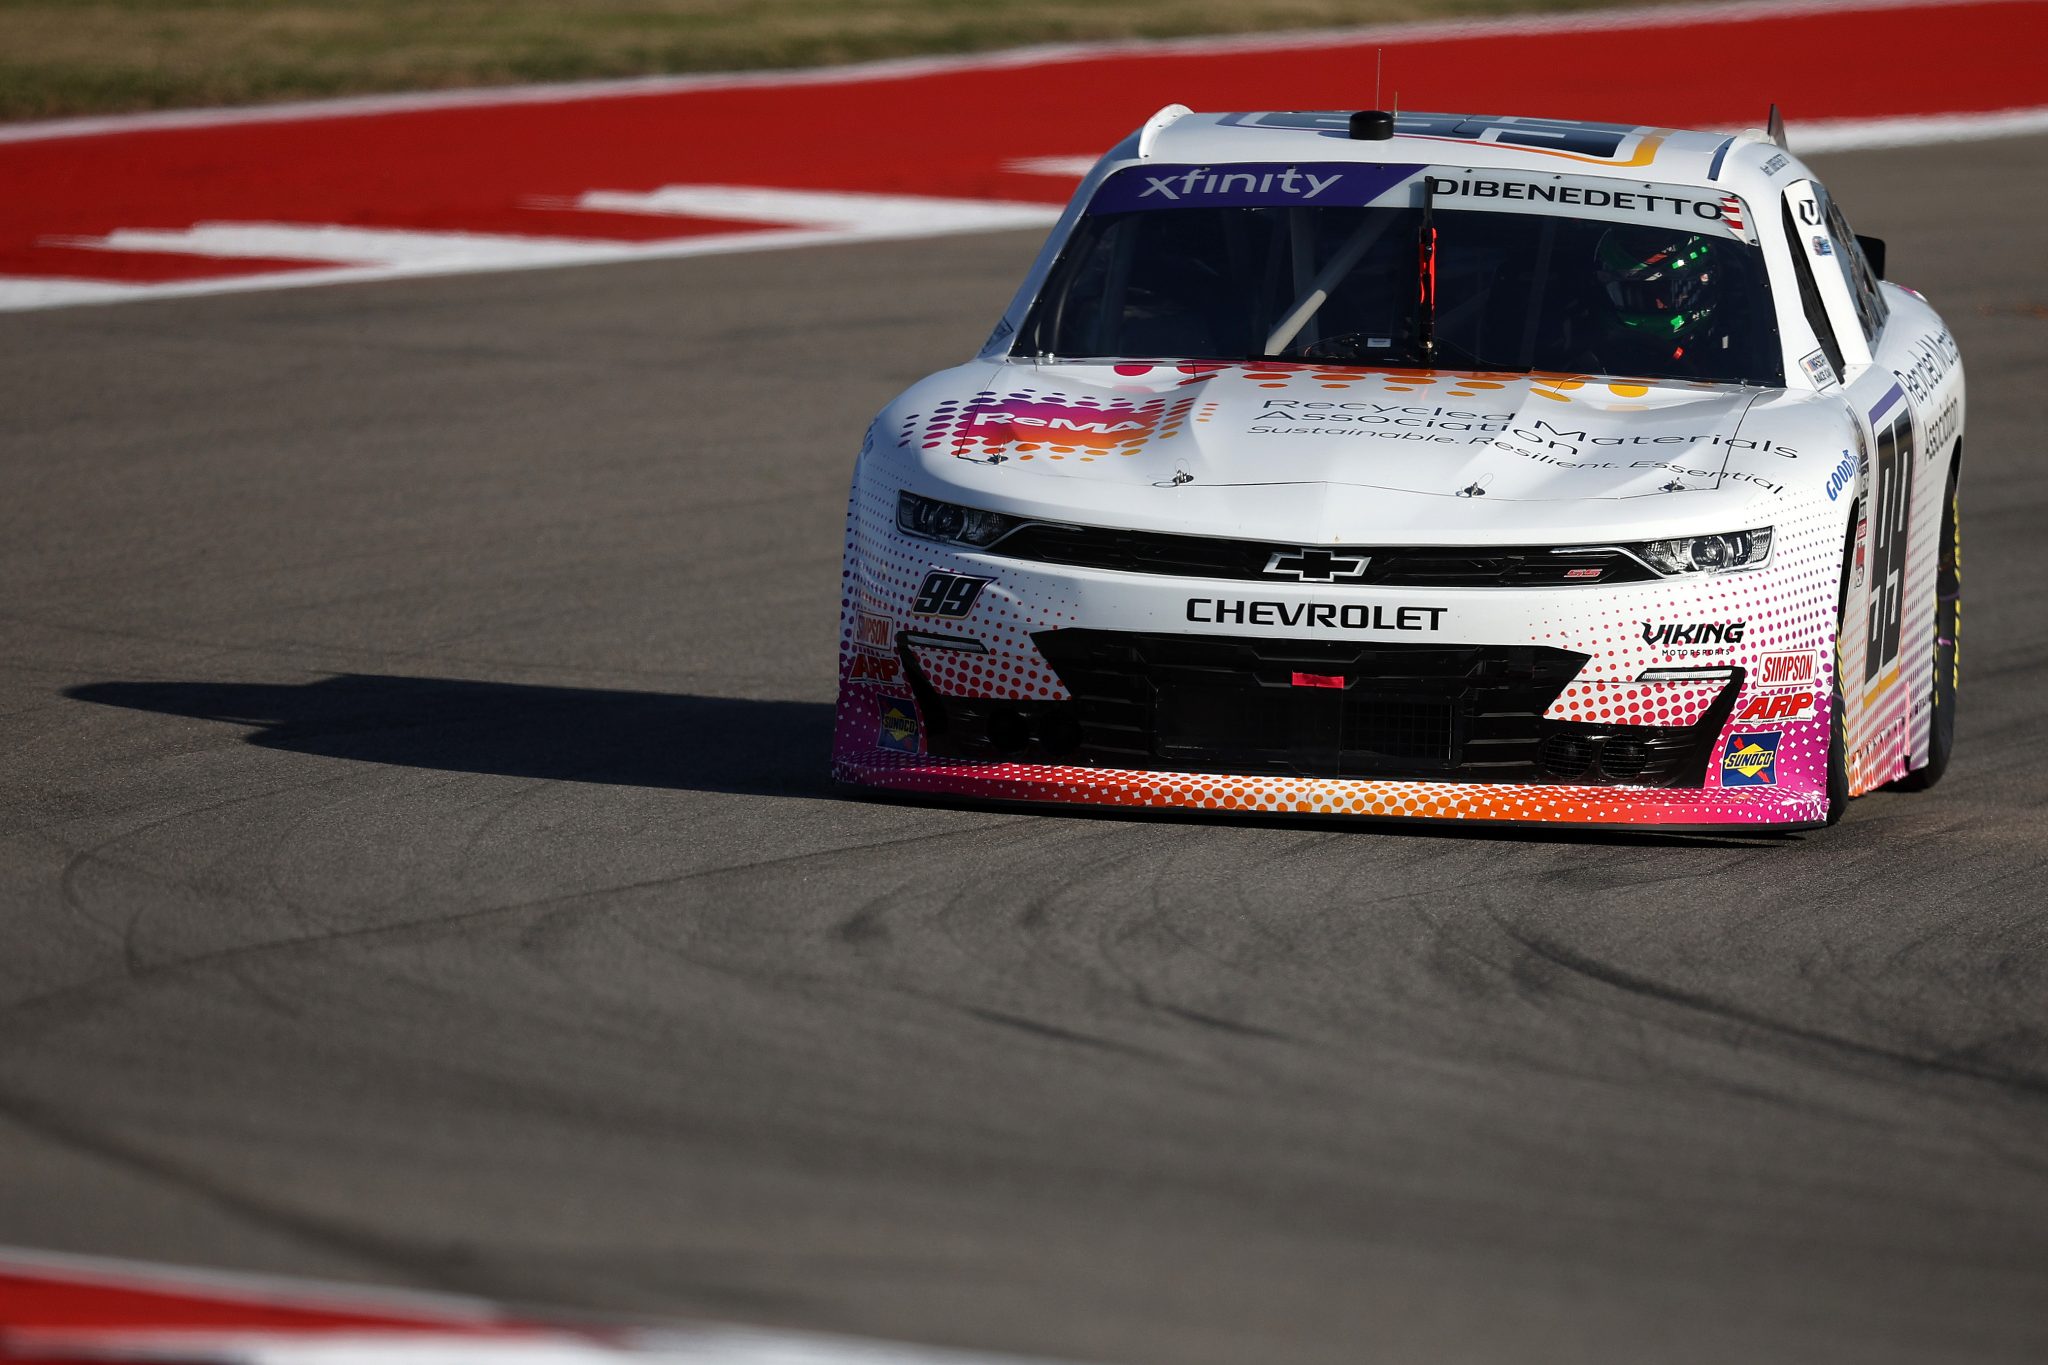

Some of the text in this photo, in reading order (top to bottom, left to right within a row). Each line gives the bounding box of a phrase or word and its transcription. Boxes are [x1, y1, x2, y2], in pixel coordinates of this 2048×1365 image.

[1139, 168, 1343, 200] xfinity
[1433, 178, 1722, 220] DIBENEDETTO
[973, 412, 1147, 433] ReMA
[1254, 410, 1579, 455] Association
[1262, 400, 1798, 459] Recycled Materials
[1247, 426, 1460, 444] Sustainable.
[1629, 460, 1784, 495] Essential
[911, 570, 993, 618] 99
[857, 614, 889, 646] SIMPSON
[1186, 598, 1448, 631] CHEVROLET
[1640, 621, 1747, 646] VIKING
[850, 654, 899, 682] ARP
[1762, 654, 1813, 683] SIMPSON
[1738, 692, 1814, 720] ARP
[884, 715, 916, 734] SUNOCO
[1726, 751, 1774, 767] SUNOCO
